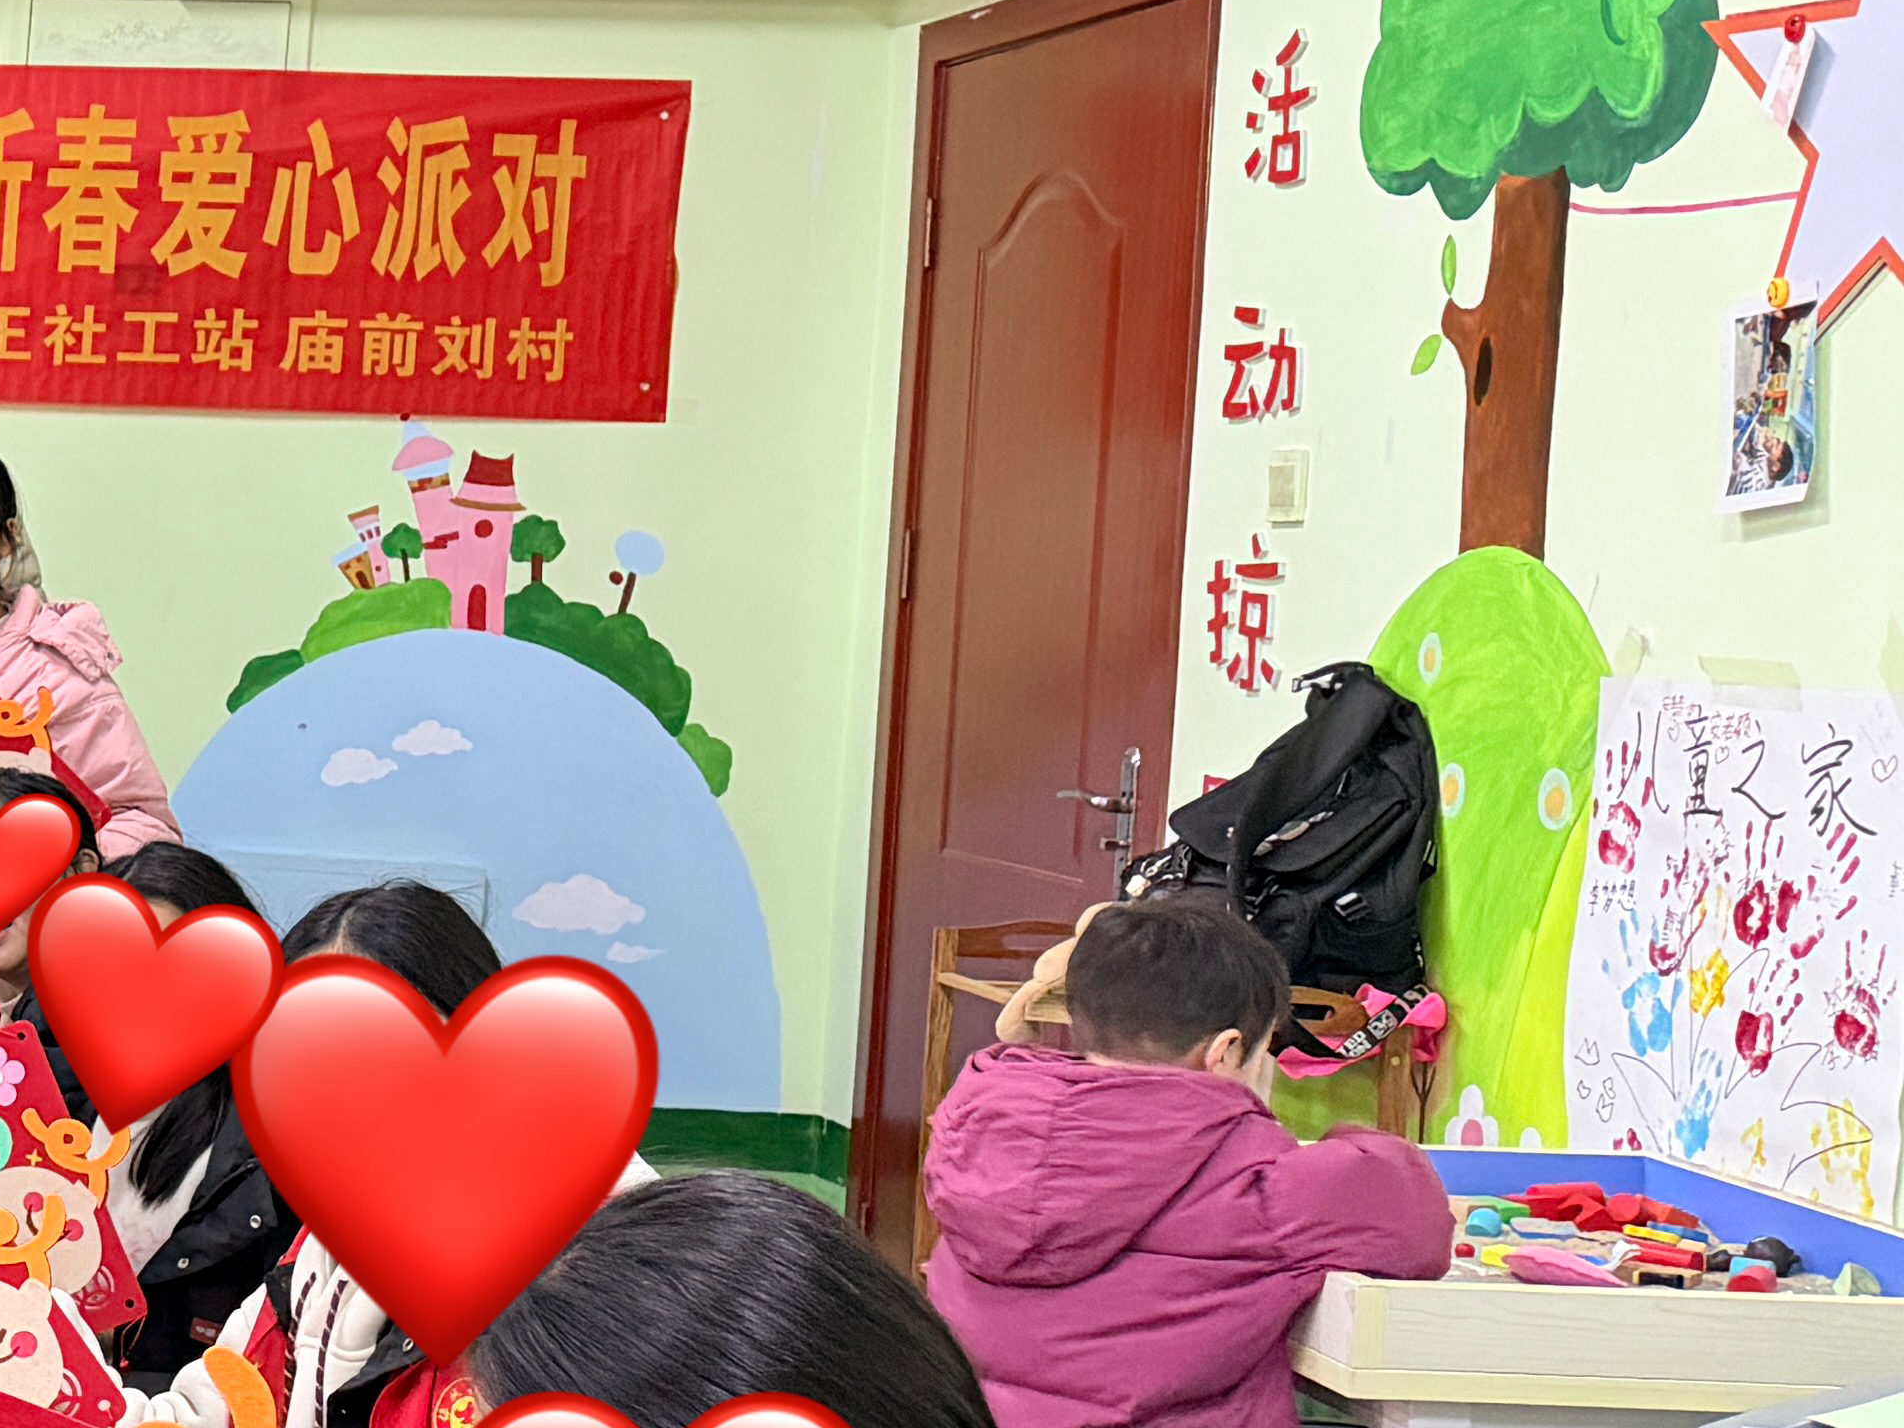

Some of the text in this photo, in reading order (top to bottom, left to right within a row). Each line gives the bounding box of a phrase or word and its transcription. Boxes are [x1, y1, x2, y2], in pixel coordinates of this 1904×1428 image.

[1203, 29, 1316, 795] 活动掠
[1617, 703, 1878, 837] 儿童之家
